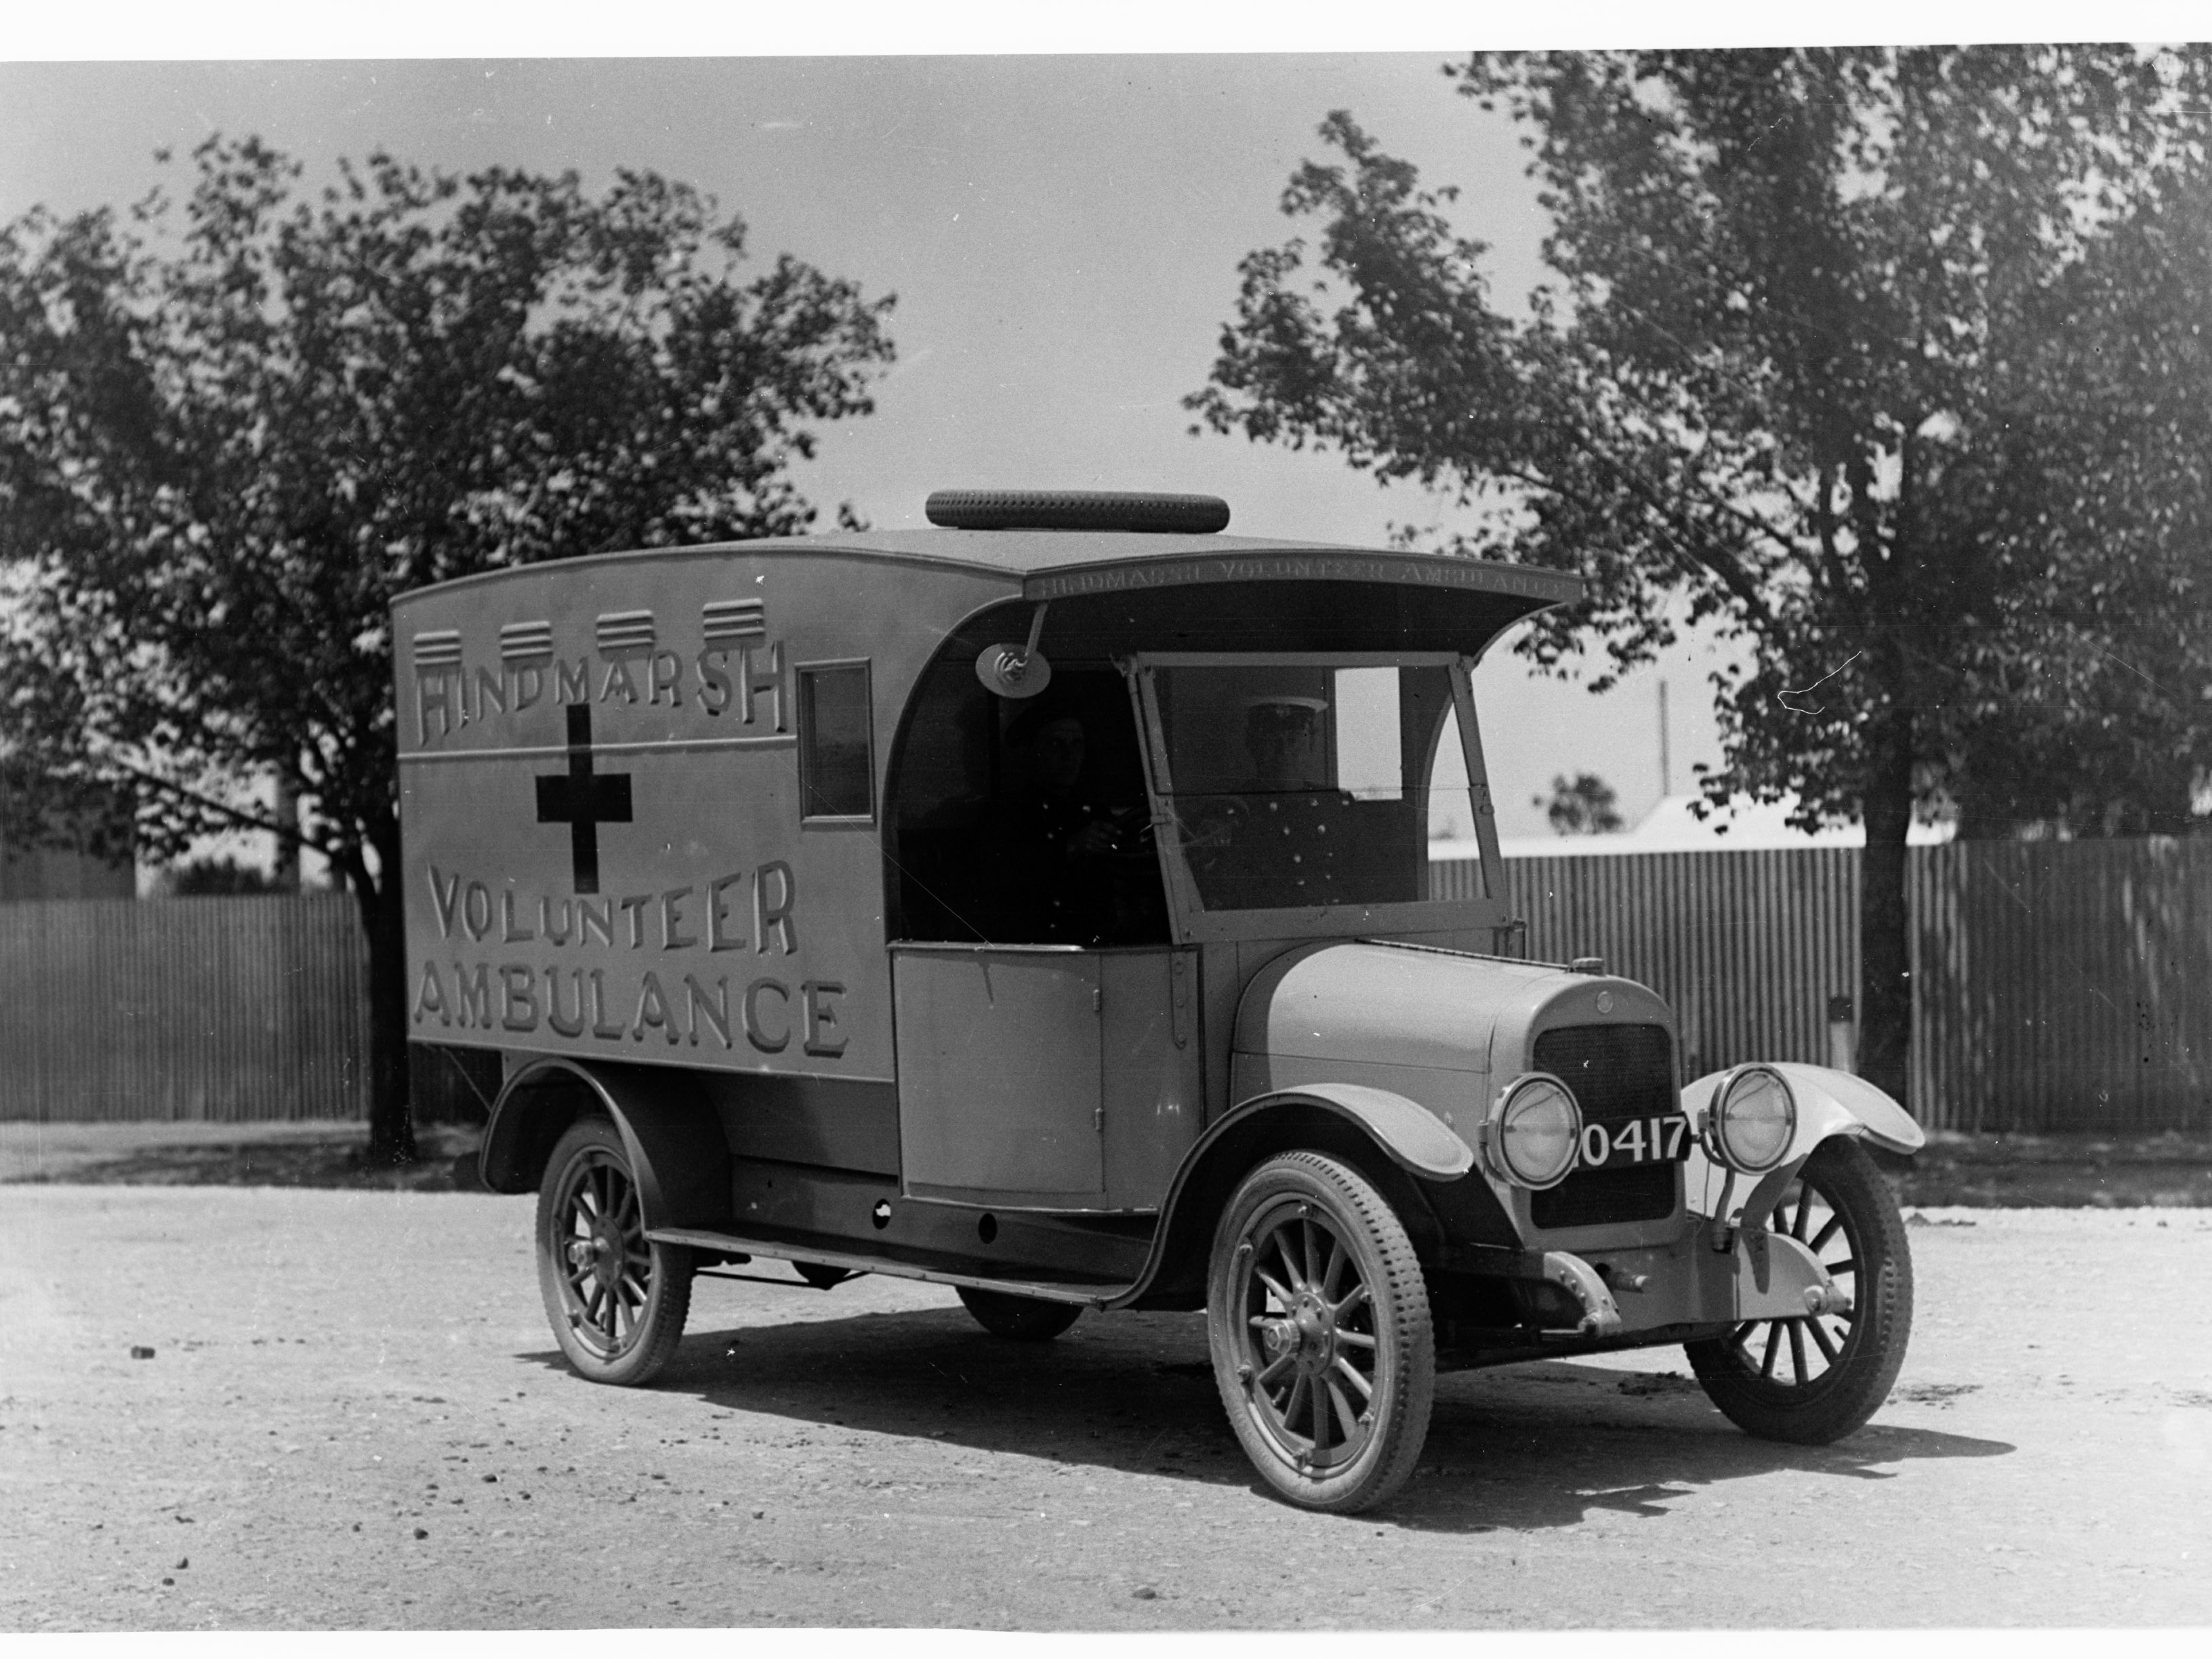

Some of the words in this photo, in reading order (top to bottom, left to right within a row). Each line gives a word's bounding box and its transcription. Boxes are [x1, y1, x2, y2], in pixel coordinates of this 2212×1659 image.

[416, 640, 787, 746] HINDMARSH
[427, 860, 798, 955] VOLUNTEER
[414, 960, 850, 1059] AMBULANCE
[1571, 1115, 1687, 1167] 0417
